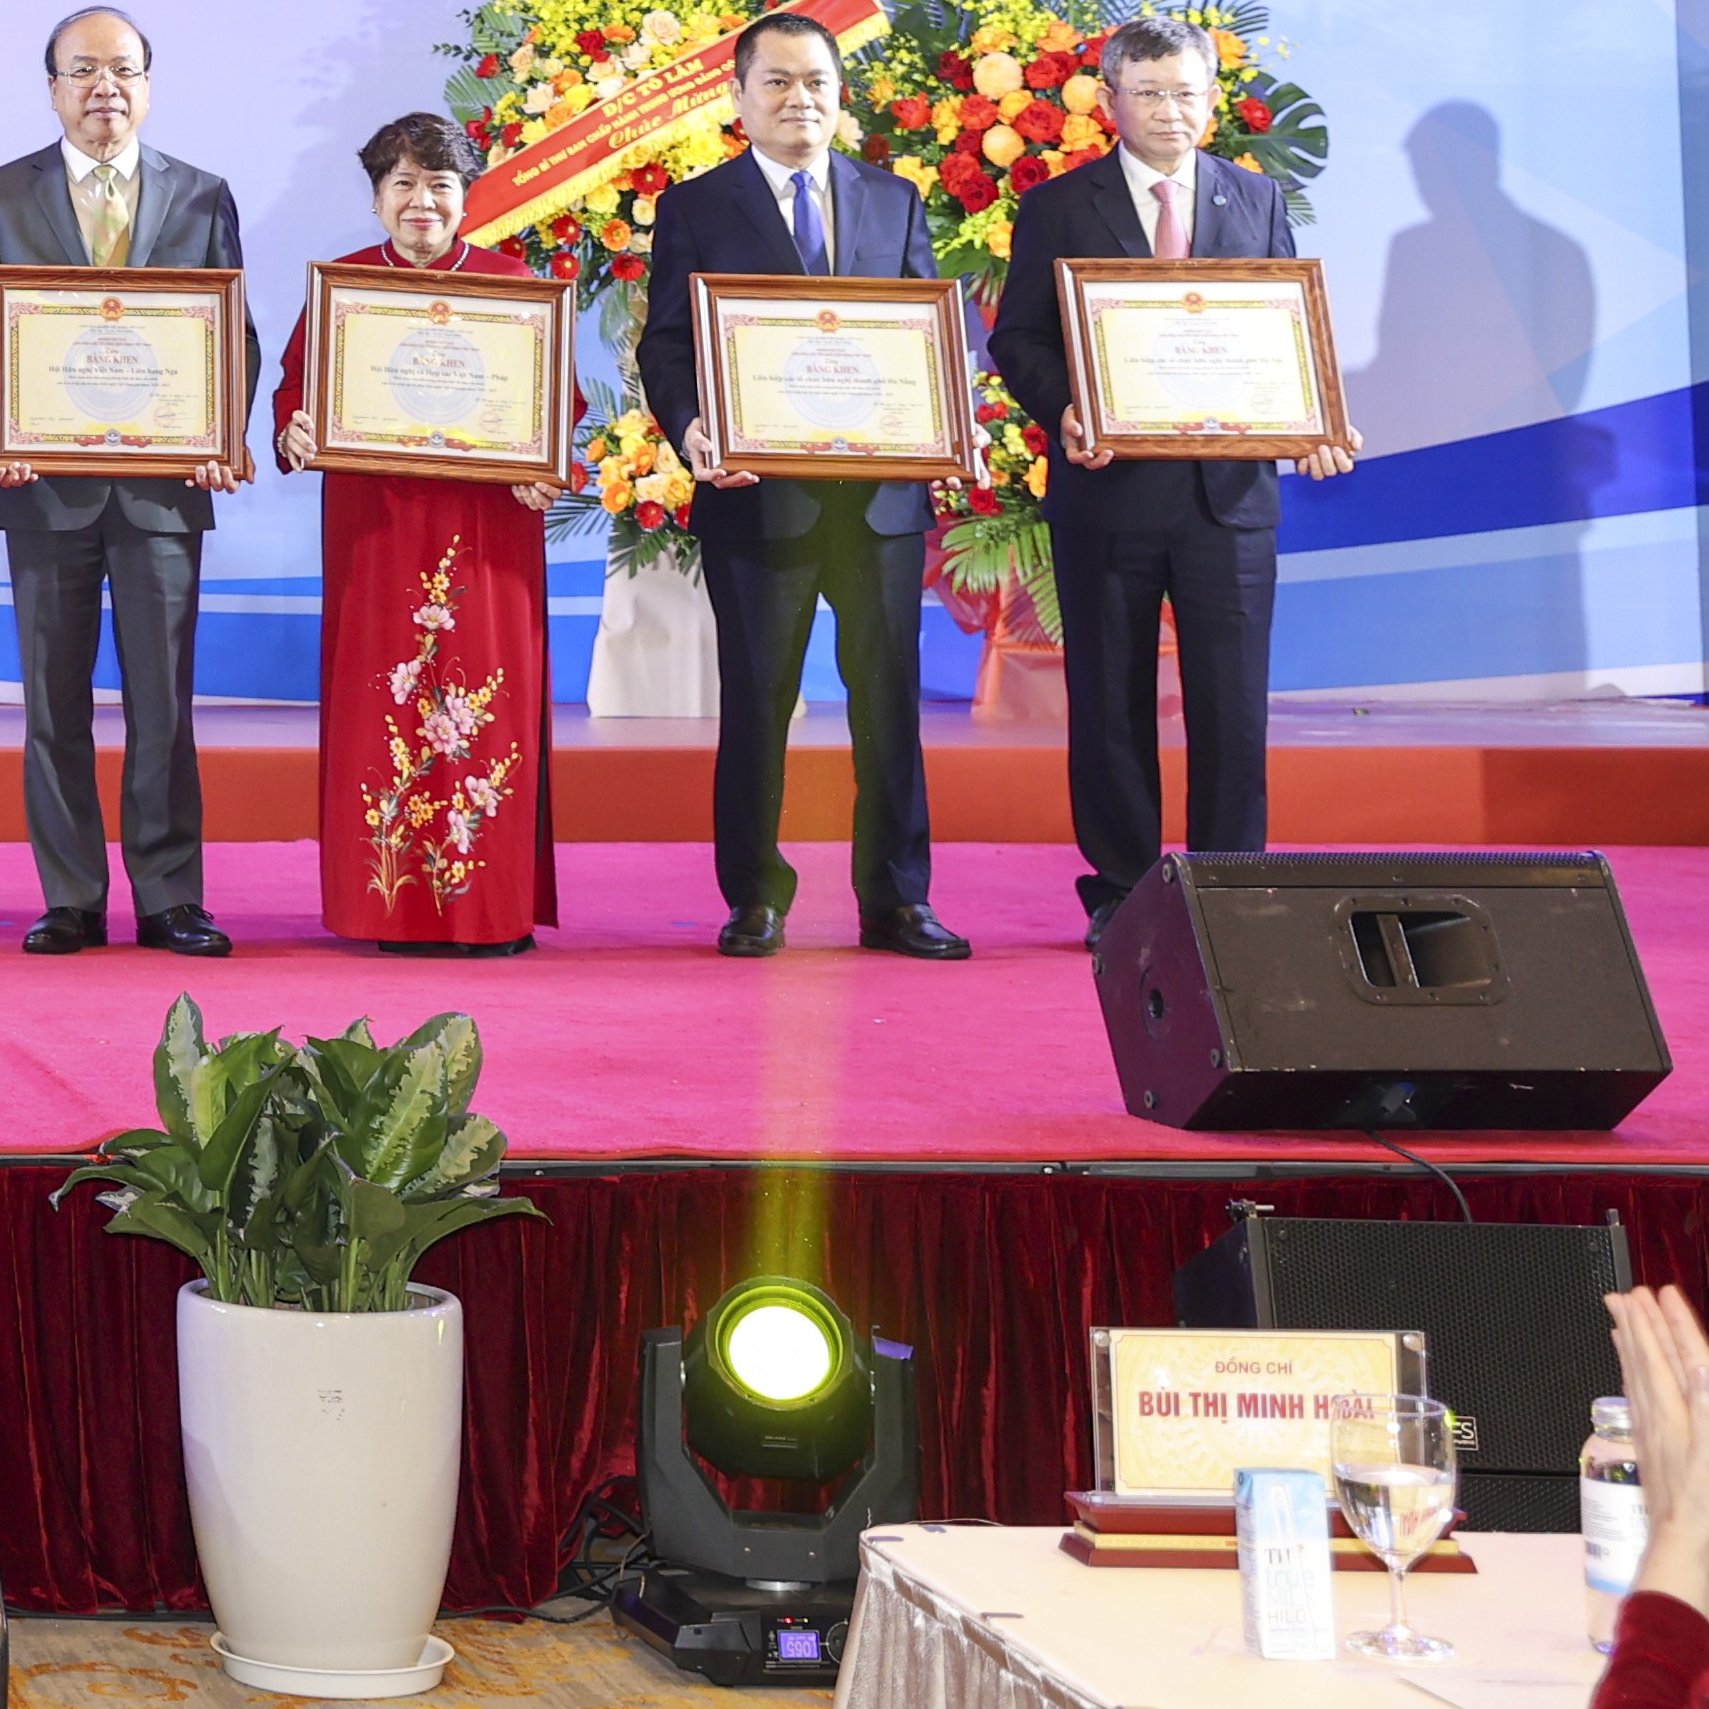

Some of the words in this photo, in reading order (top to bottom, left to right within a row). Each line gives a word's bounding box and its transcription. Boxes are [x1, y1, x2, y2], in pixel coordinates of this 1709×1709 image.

[601, 91, 637, 118] Đ/C
[639, 73, 664, 97] TÔ
[666, 58, 705, 84] LÂM
[607, 115, 664, 149] Chúc
[669, 81, 731, 119] Mừng
[512, 165, 539, 186] TỔNG
[549, 149, 568, 167] THƯ
[567, 141, 587, 157] BAN
[585, 123, 612, 148] CHẤP
[639, 96, 669, 115] TRUNG
[114, 355, 138, 365] KHEN
[1267, 1359, 1293, 1375] CHÍ
[1139, 1387, 1180, 1417] BÙI
[1189, 1391, 1228, 1424] THỊ
[1237, 1393, 1304, 1419] MINH
